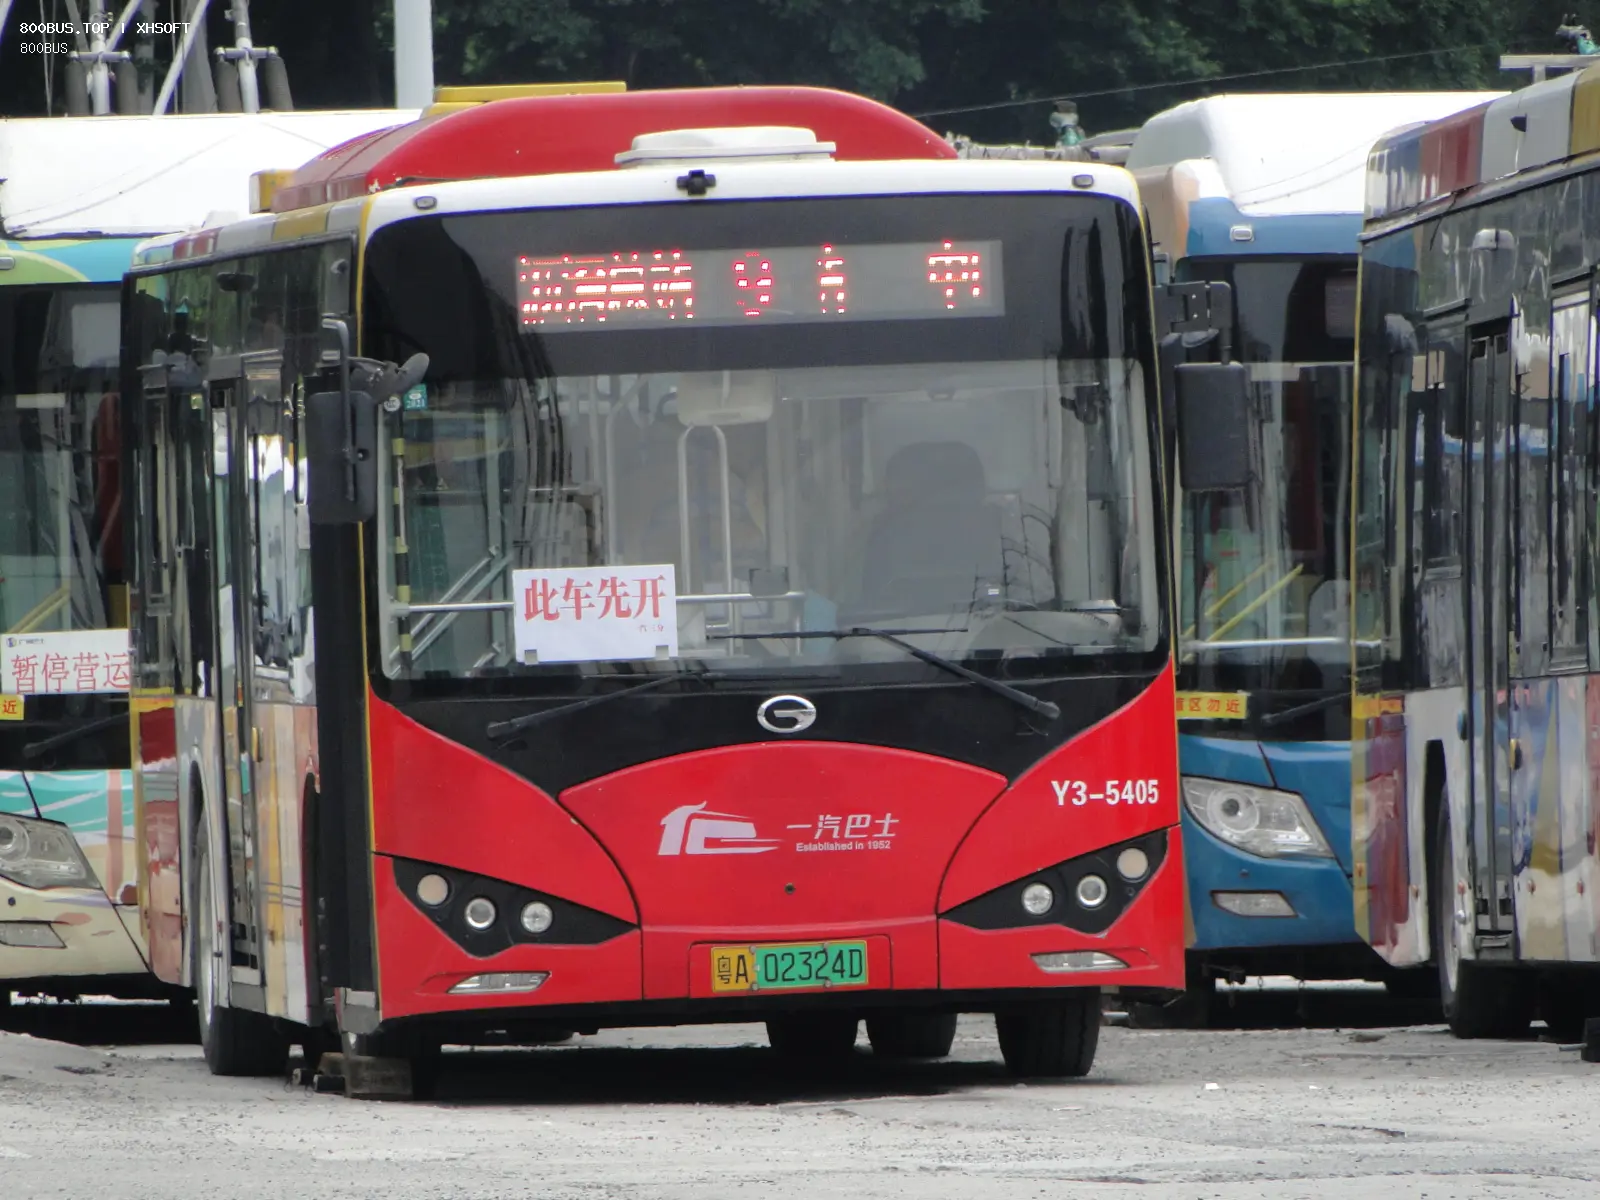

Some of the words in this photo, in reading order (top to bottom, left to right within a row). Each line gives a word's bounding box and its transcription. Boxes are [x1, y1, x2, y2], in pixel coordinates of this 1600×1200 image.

[524, 575, 666, 622] 此车先开
[11, 652, 131, 695] 暂停营运
[1051, 779, 1159, 806] Y3-5405
[786, 813, 900, 839] 一汽巴士
[796, 841, 853, 851] Established
[855, 841, 864, 850] in
[867, 840, 891, 850] 1952
[717, 954, 749, 985] 粤A
[763, 948, 863, 982] 02324D
